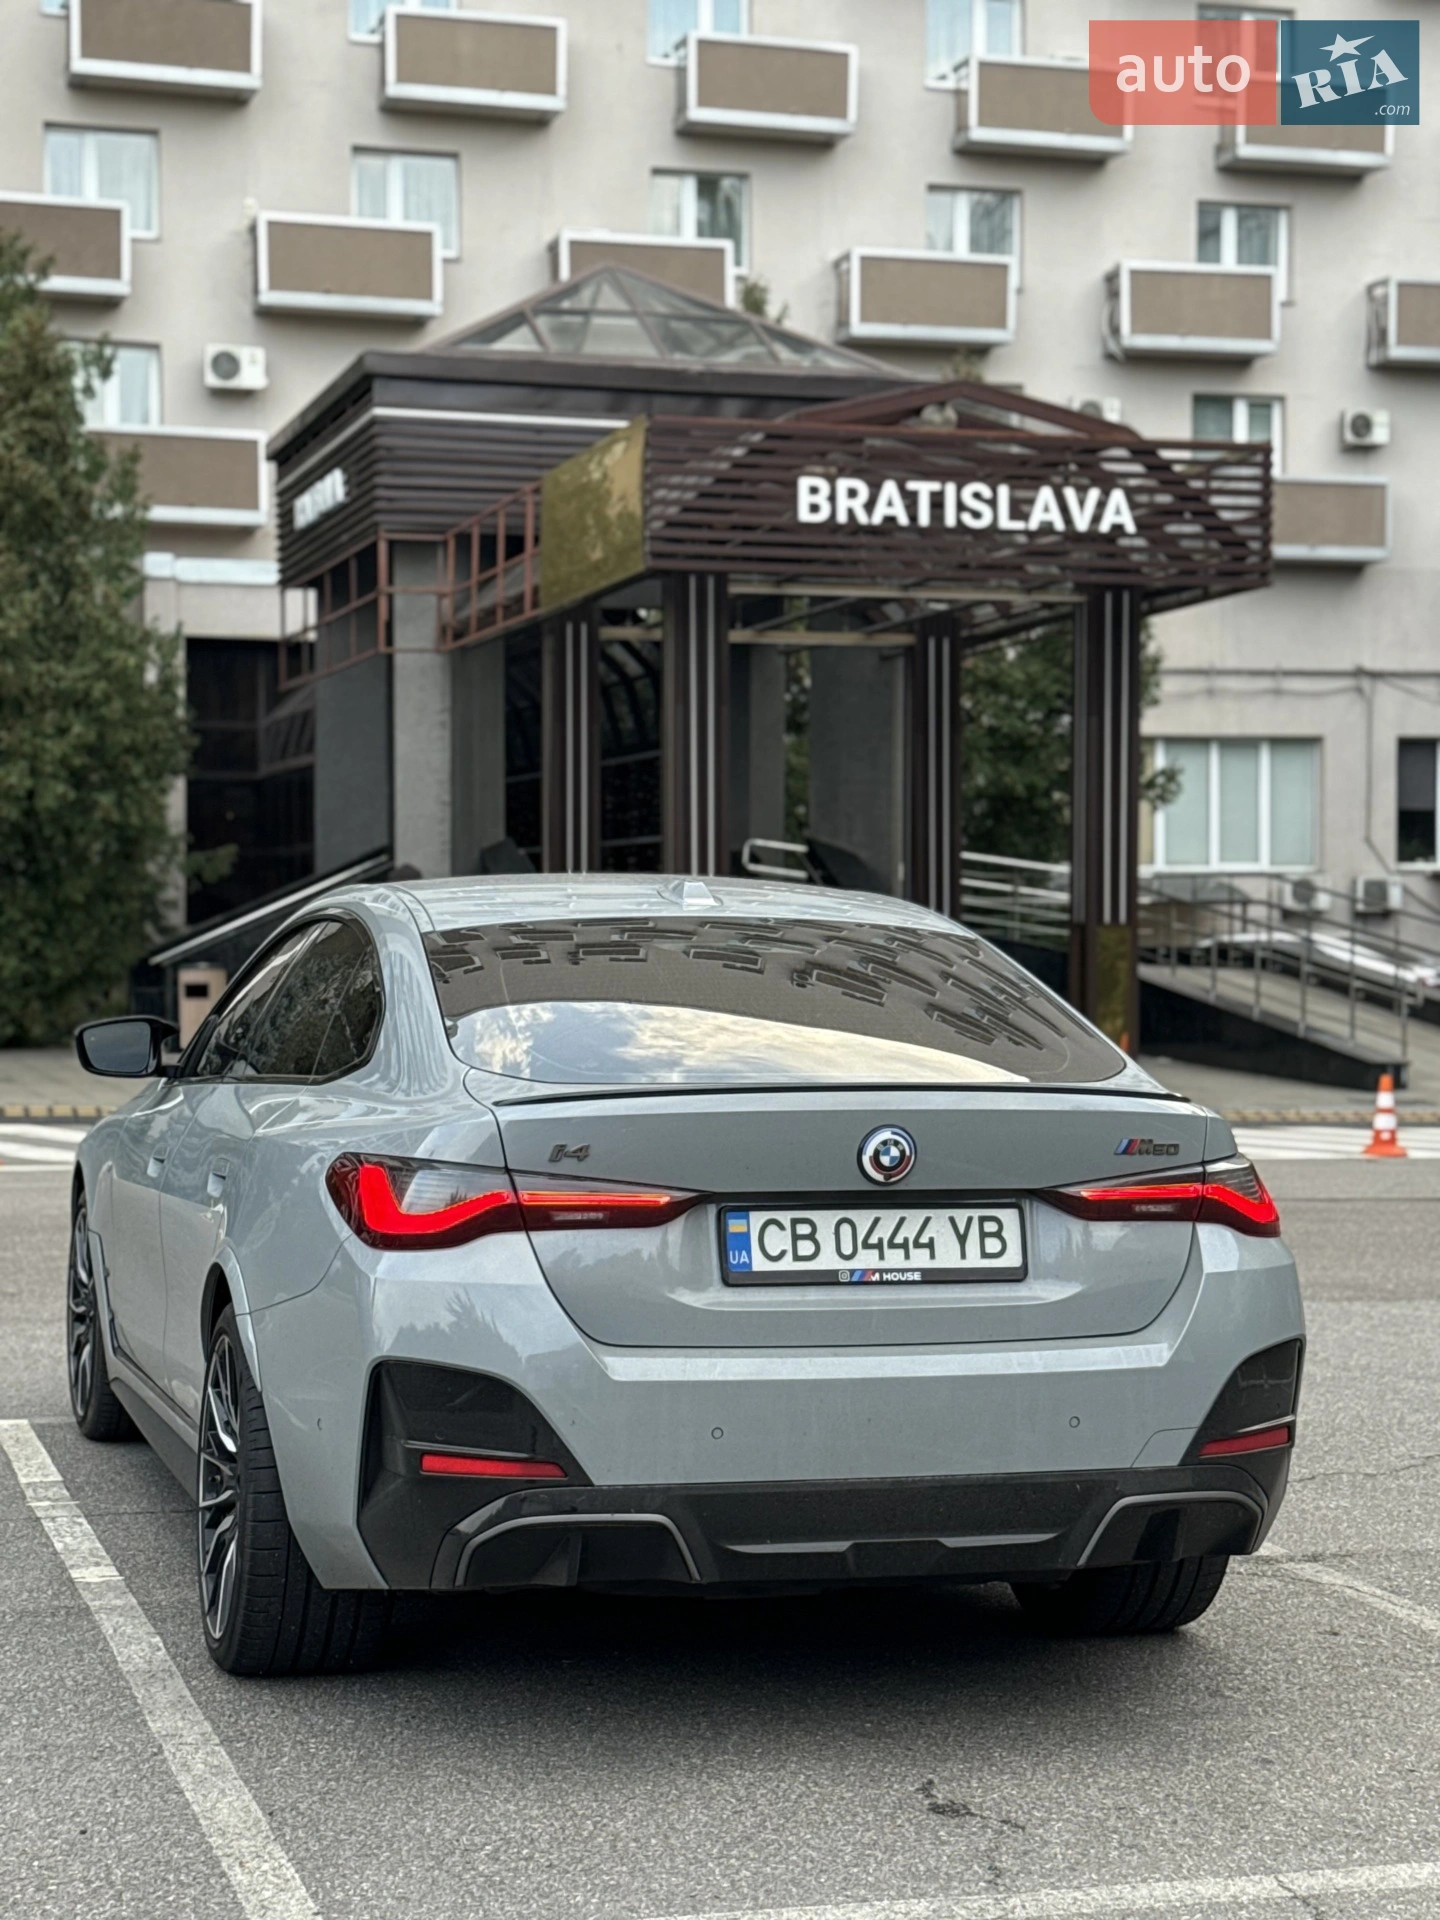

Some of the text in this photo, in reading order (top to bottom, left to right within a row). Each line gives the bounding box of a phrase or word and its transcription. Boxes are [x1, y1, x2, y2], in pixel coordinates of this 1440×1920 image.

[796, 475, 1137, 534] BRATISLAVA
[547, 1144, 591, 1161] i4
[758, 1215, 1007, 1262] CB 0444 YB
[729, 1251, 750, 1264] UA
[882, 1271, 922, 1281] HOUSE
